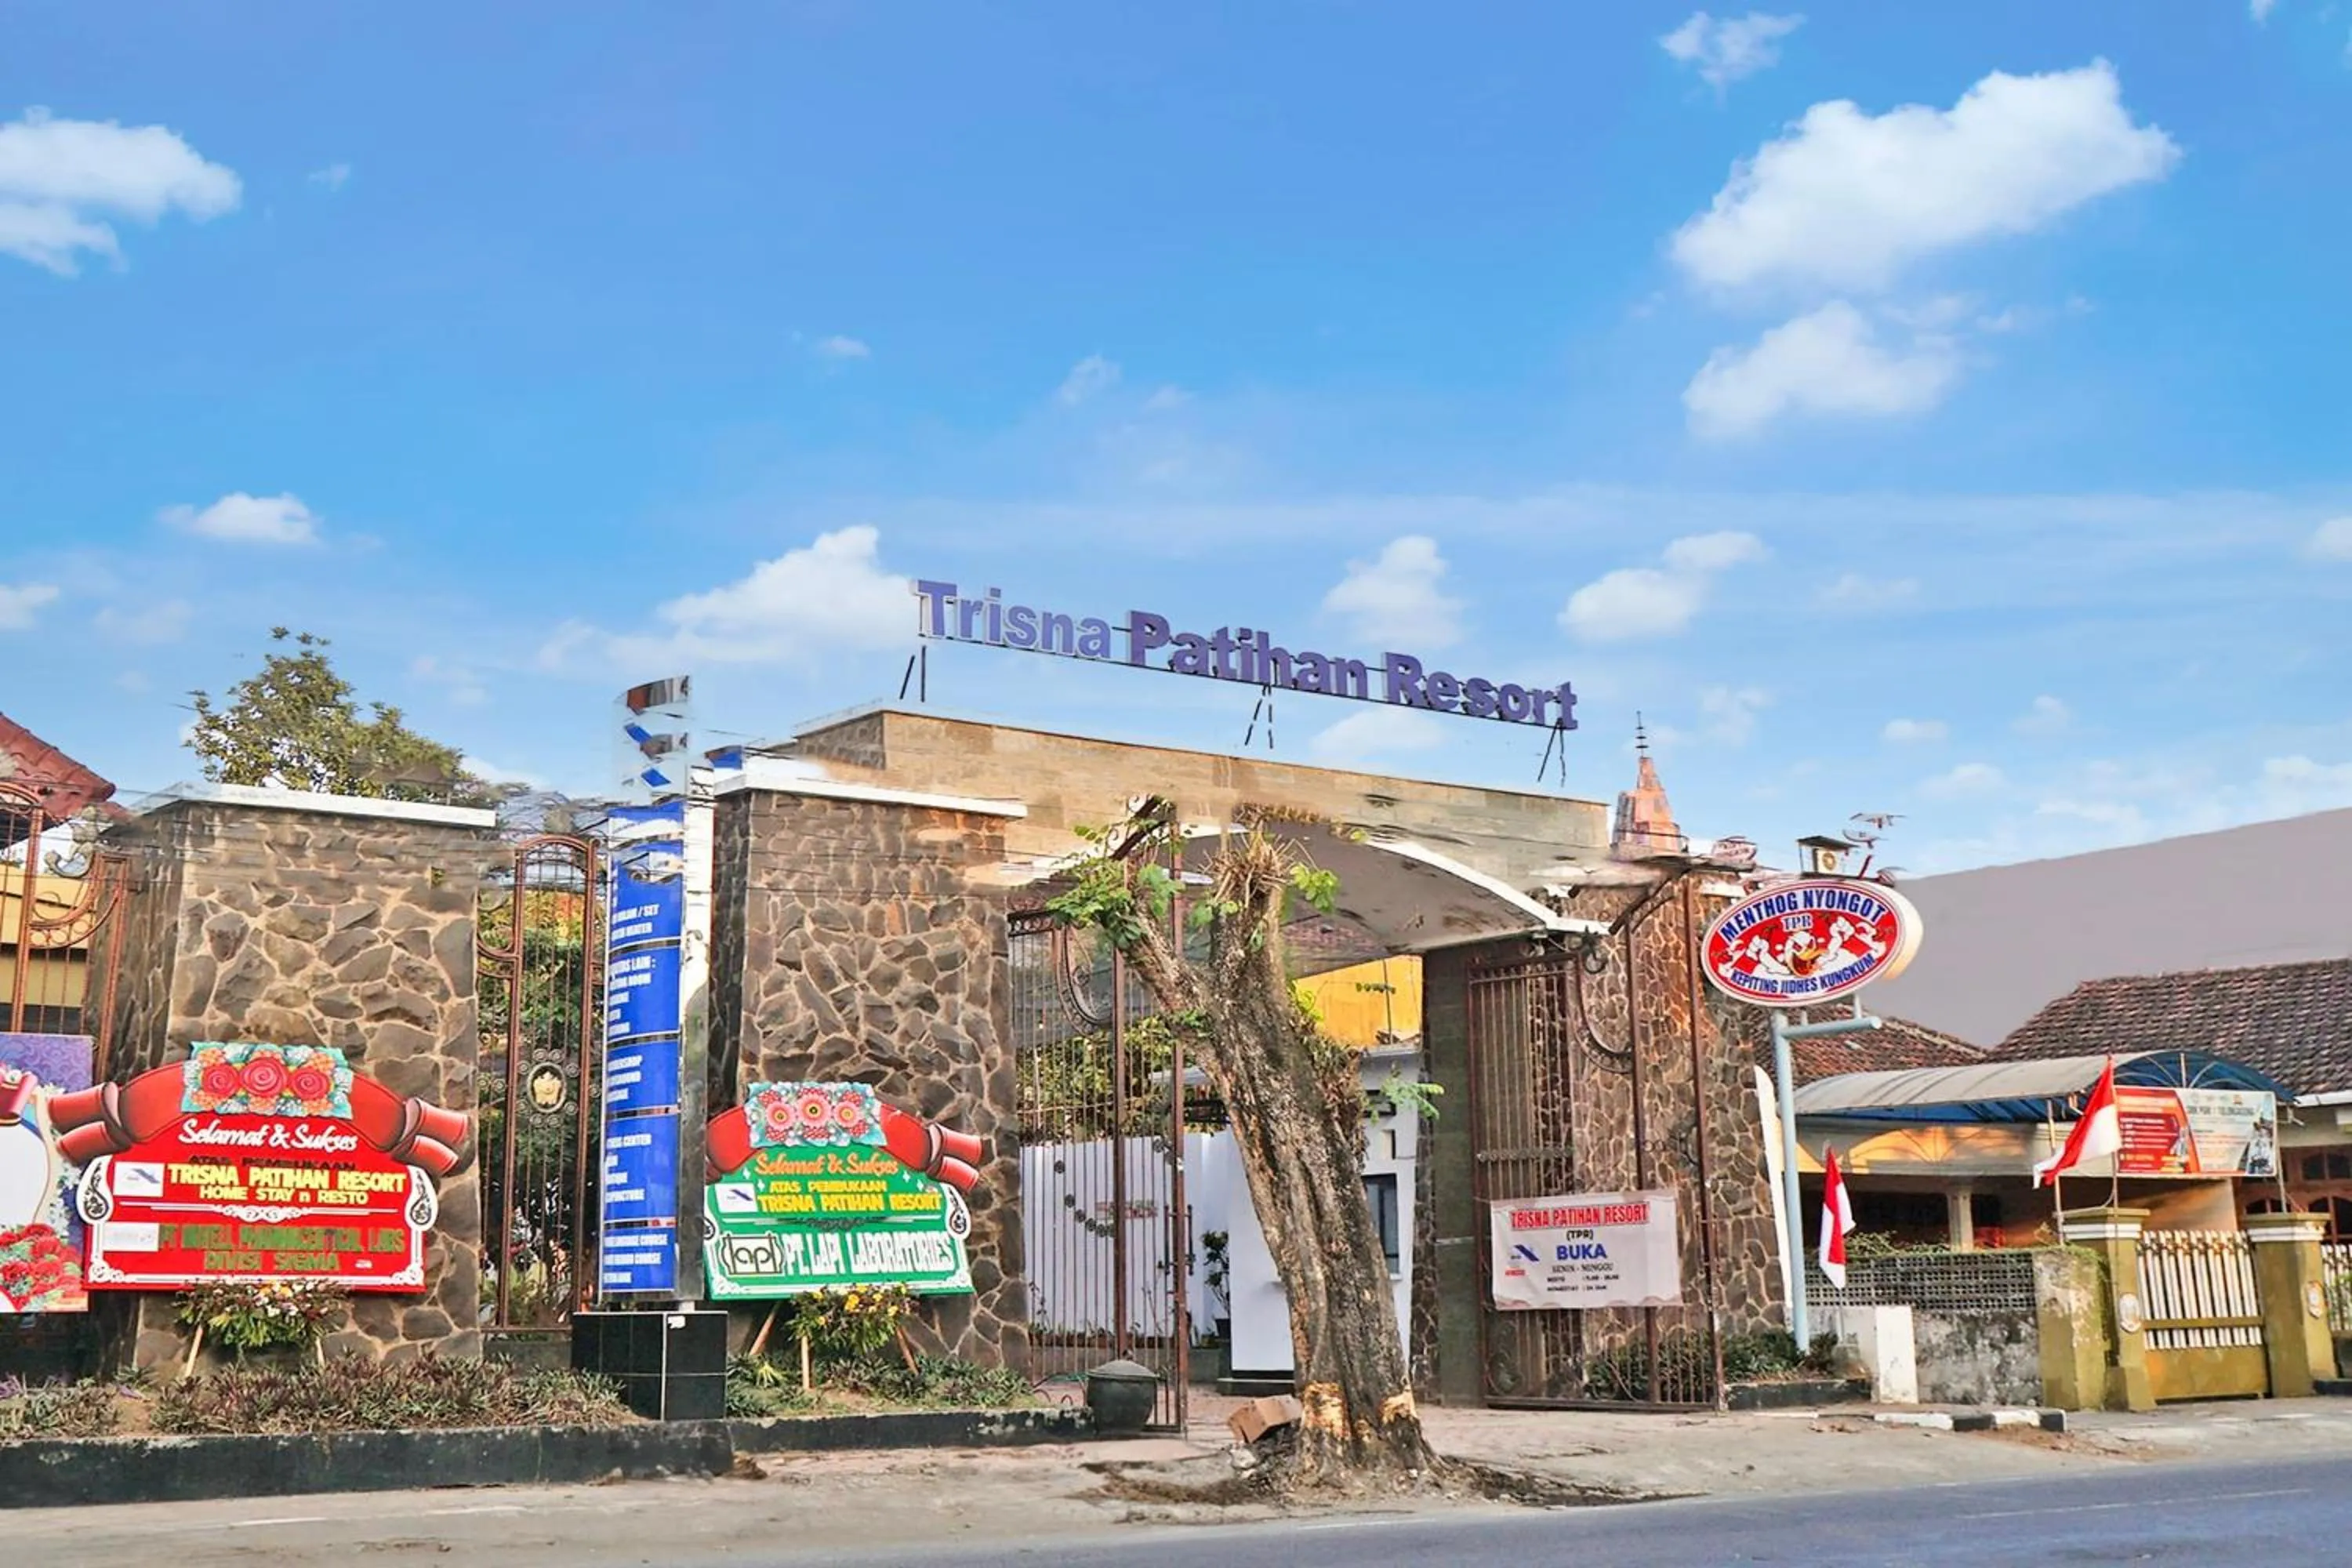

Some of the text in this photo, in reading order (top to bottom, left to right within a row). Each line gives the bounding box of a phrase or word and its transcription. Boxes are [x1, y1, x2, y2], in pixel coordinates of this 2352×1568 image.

[911, 579, 1578, 731] Trisna Patihan Resort
[1719, 889, 1886, 944] MENTHOG NYONGOT
[1781, 913, 1813, 931] TPR
[1730, 969, 1778, 993] KEPITING
[1820, 953, 1876, 989] KUNGKUM
[179, 1118, 358, 1152] Selamat & Sukses
[754, 1152, 898, 1177] Selamat & Sukses
[167, 1164, 407, 1192] TRISNA PATIHAN RESORT
[769, 1181, 887, 1192] ATAS PEMBUKAAN
[199, 1186, 248, 1201] HOME
[256, 1188, 295, 1202] STAY
[318, 1189, 368, 1205] RESTO
[757, 1193, 942, 1213] TRISNA PATIHAN RESORT
[1511, 1203, 1650, 1229] TRISNA PATIHAN RESORT
[1566, 1229, 1594, 1241] (TPR)
[806, 1232, 846, 1276] LAPI
[847, 1230, 955, 1273] LABORATORIES
[1556, 1243, 1607, 1261] BUKA
